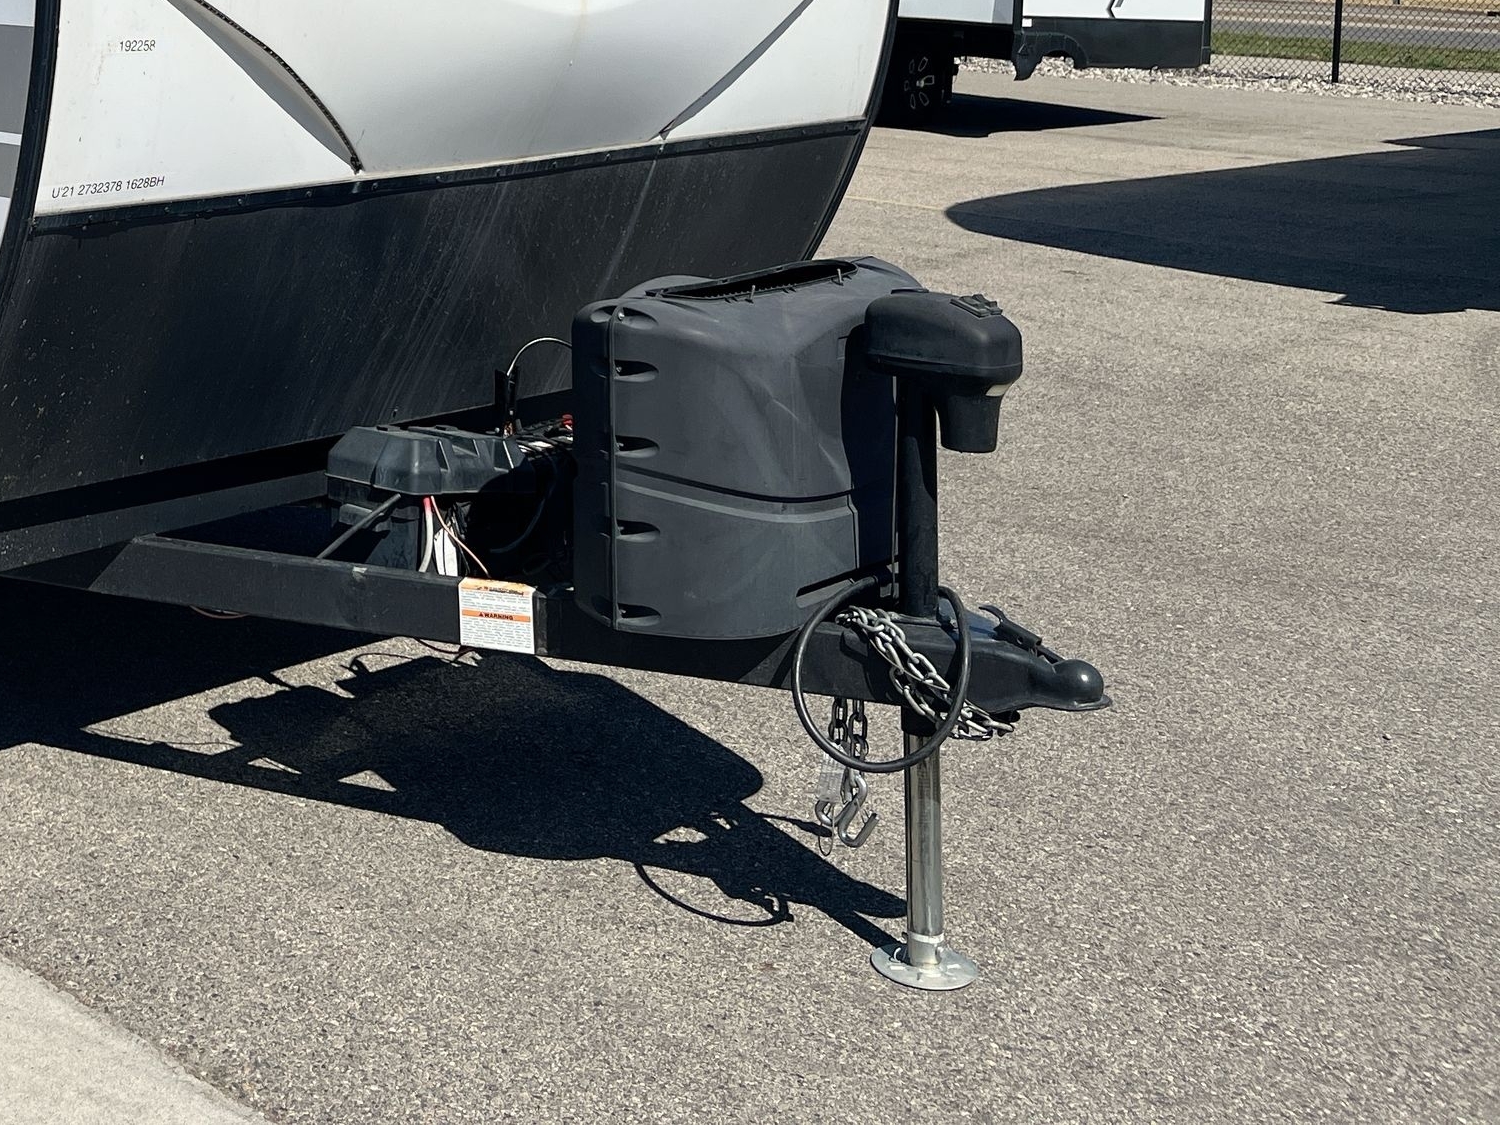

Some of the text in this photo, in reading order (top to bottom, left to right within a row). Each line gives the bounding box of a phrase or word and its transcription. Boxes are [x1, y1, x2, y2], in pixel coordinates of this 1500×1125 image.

[77, 180, 122, 196] 2732378
[126, 176, 165, 190] 1628BH
[485, 611, 514, 621] WARNING
